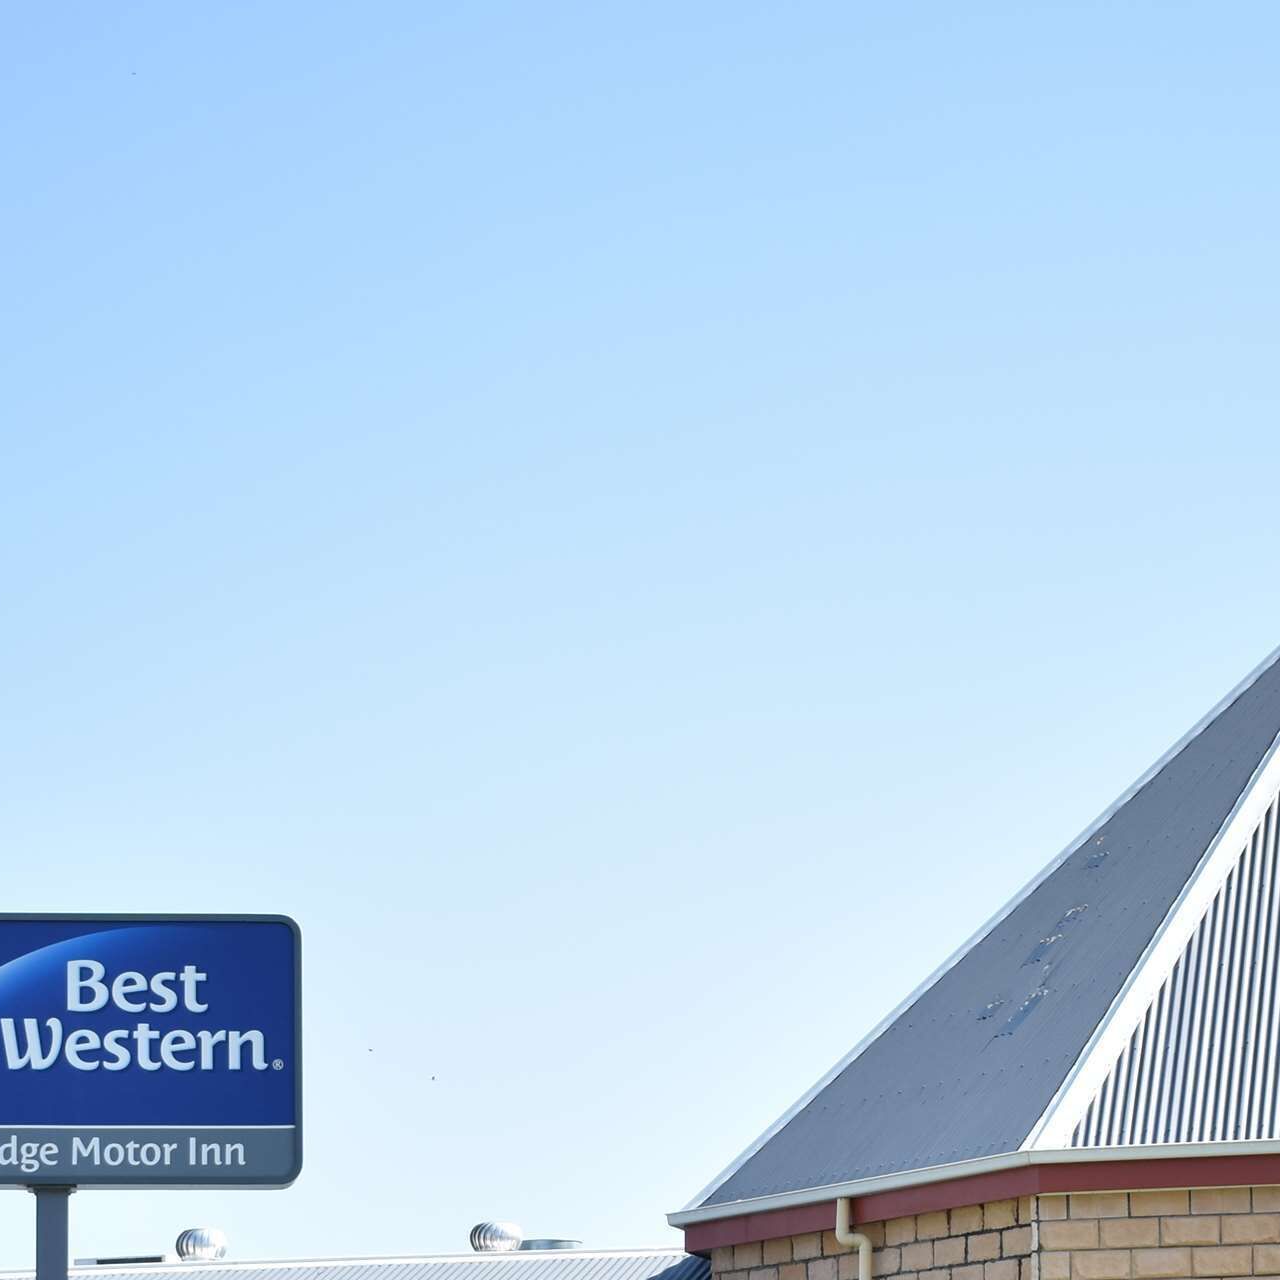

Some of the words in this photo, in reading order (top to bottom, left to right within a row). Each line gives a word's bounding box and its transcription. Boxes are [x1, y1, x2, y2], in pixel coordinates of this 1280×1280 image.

[66, 959, 209, 1013] Best
[71, 1136, 178, 1166] Motor
[188, 1137, 246, 1165] Inn
